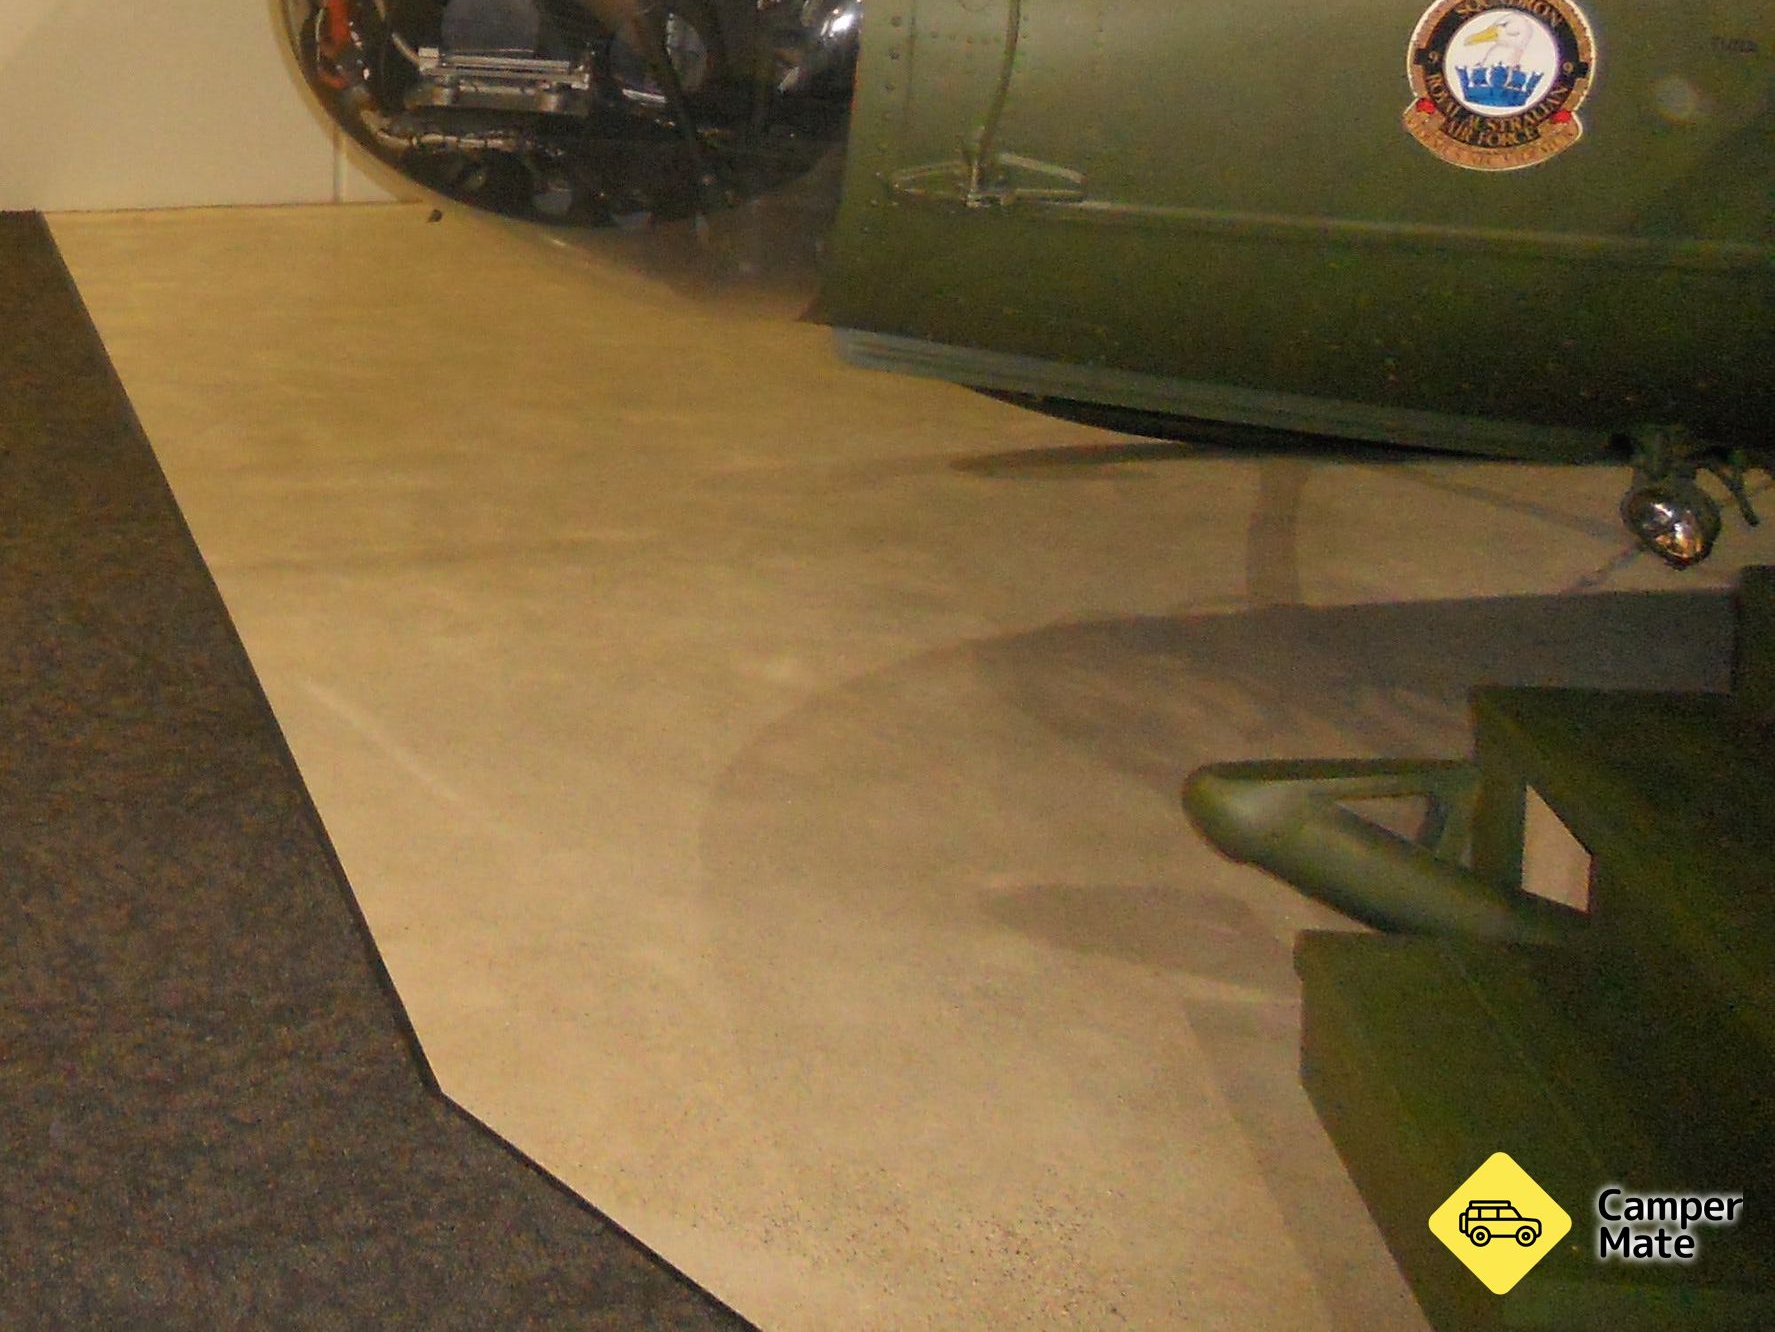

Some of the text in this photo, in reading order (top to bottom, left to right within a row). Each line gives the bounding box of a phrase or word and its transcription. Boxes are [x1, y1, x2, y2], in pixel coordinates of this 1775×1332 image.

[1426, 73, 1459, 118] ROYAL
[1446, 119, 1475, 143] AIR
[1476, 123, 1539, 147] FORCE
